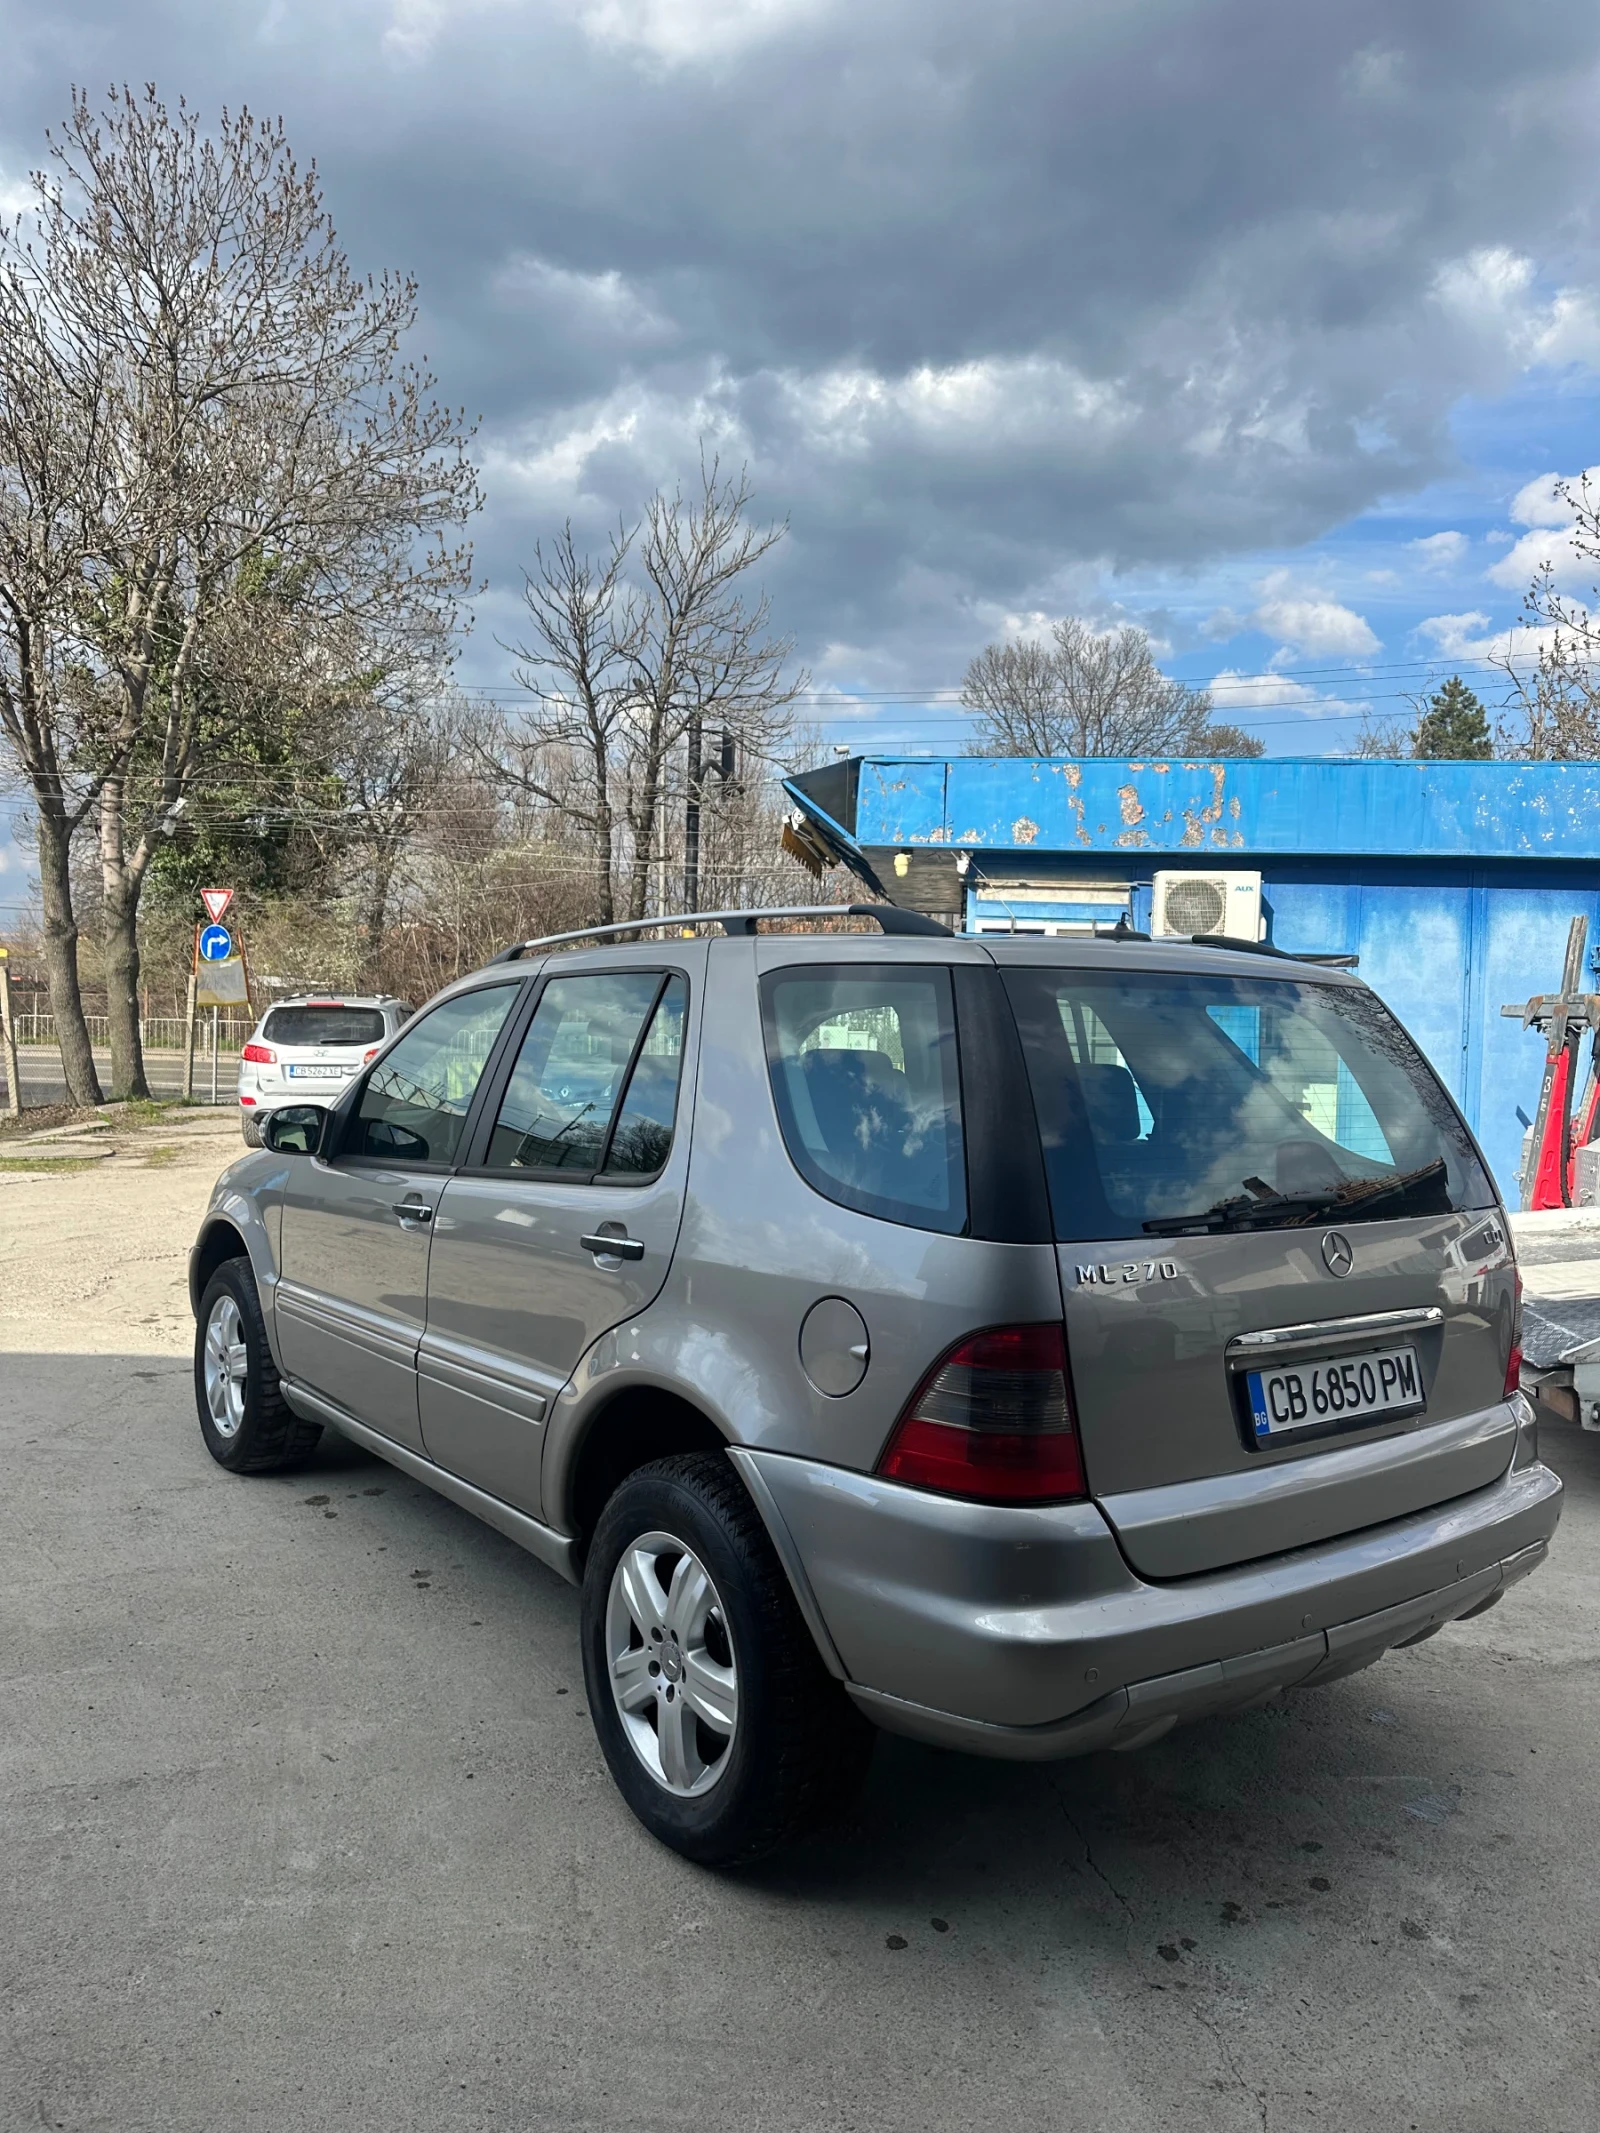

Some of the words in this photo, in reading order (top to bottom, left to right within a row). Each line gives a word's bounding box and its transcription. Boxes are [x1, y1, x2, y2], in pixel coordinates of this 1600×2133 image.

[295, 1066, 306, 1075] CB
[307, 1066, 327, 1075] 5262
[1483, 1230, 1503, 1244] CDI
[1075, 1264, 1117, 1284] ML
[1122, 1262, 1178, 1283] 270
[1268, 1374, 1307, 1423] CB
[1312, 1362, 1377, 1415] 6850
[1378, 1354, 1418, 1402] PM
[1254, 1412, 1267, 1427] BG
